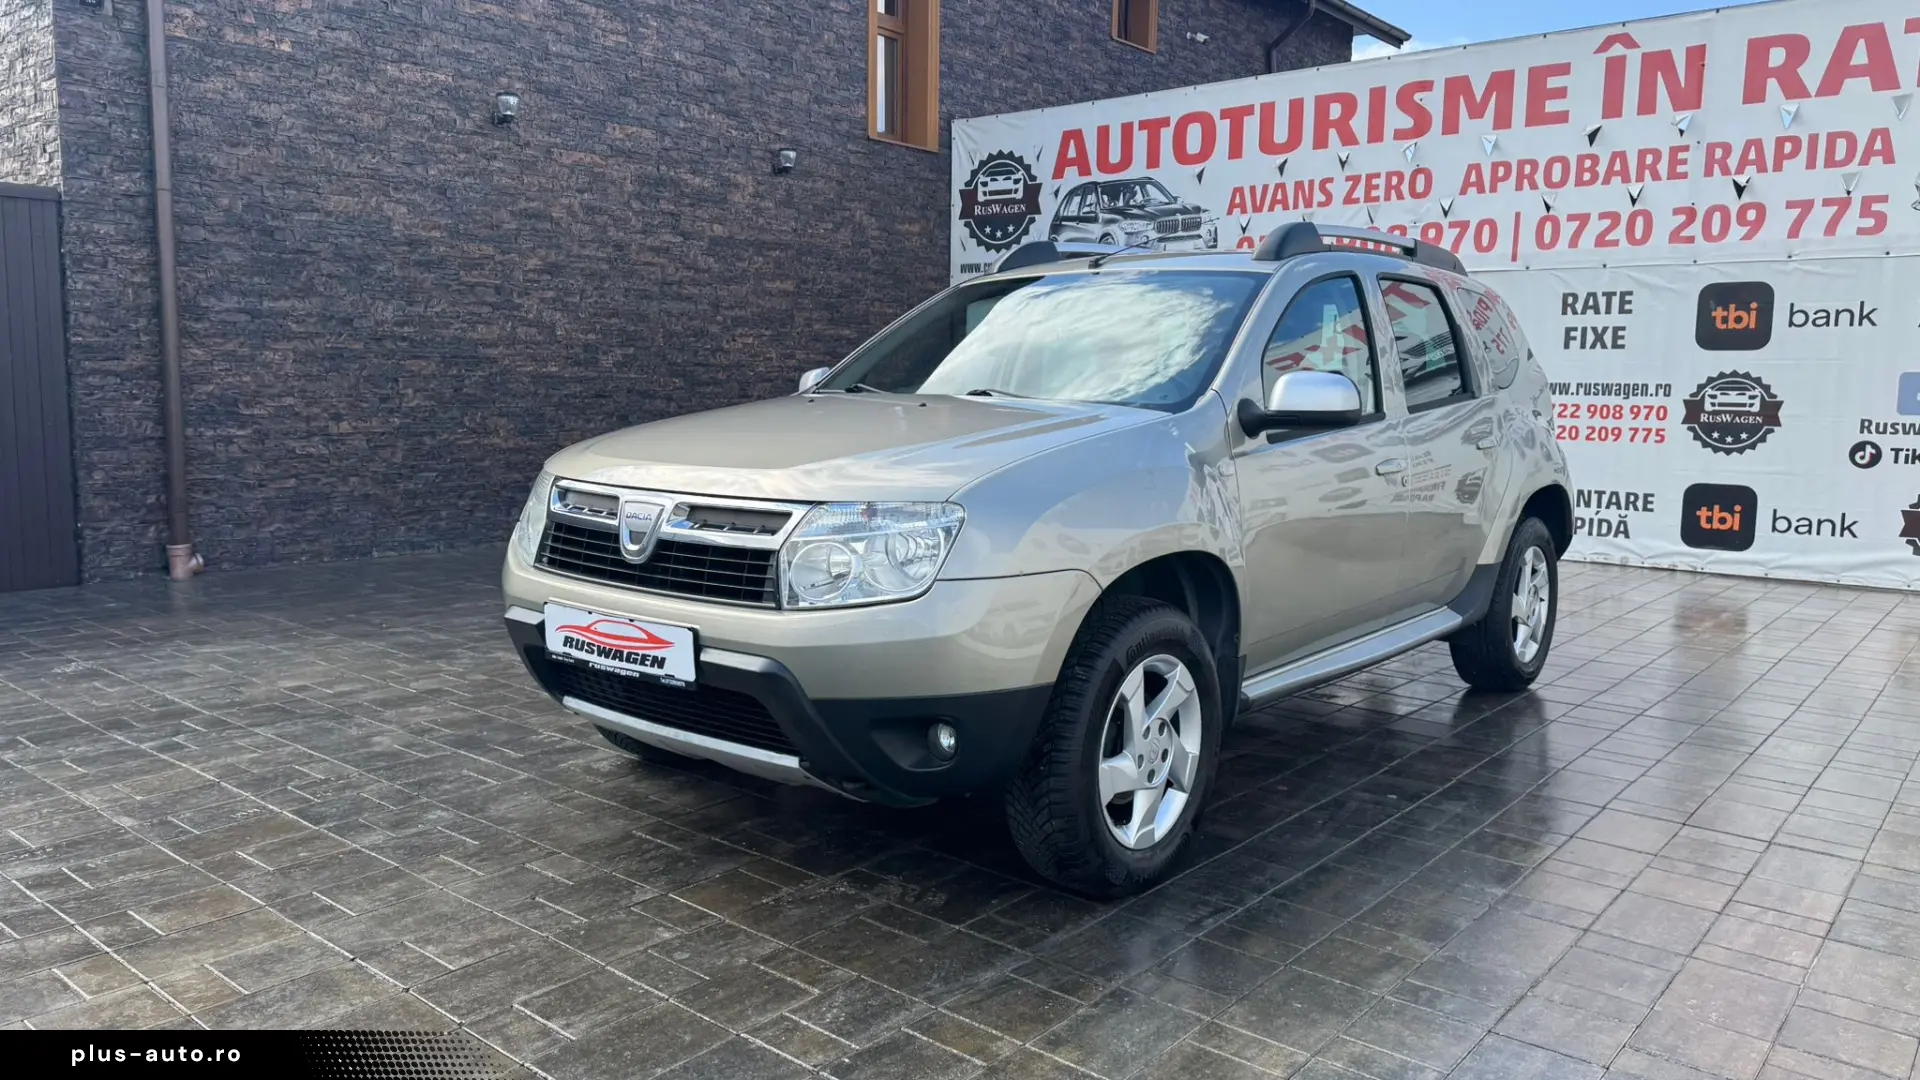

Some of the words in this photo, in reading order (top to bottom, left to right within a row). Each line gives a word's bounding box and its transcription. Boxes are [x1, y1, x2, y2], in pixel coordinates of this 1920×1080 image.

[1051, 62, 1571, 179] AUTOTURISME
[1593, 32, 1706, 119] ÎN
[1226, 177, 1334, 216] AVANS
[1343, 166, 1433, 205] ZERO
[1459, 144, 1690, 195] APROBARE
[1703, 127, 1896, 178] RAPIDA
[1420, 218, 1498, 254] 970
[1535, 209, 1653, 250] 0720
[1668, 202, 1766, 245] 209
[1784, 194, 1889, 239] 775
[1561, 290, 1634, 316] RATE
[1711, 301, 1758, 330] tbi
[1788, 301, 1878, 328] bank
[1563, 326, 1627, 350] FIXE
[1587, 404, 1624, 420] 908
[1629, 405, 1668, 421] 970
[1555, 425, 1579, 441] 20
[1585, 426, 1622, 442] 209
[1628, 427, 1666, 443] 775
[626, 511, 653, 521] DACIA
[1696, 504, 1742, 531] tbi
[1771, 508, 1859, 539] bank
[562, 635, 667, 669] RUSWAGEN
[589, 662, 640, 678] ruswagen
